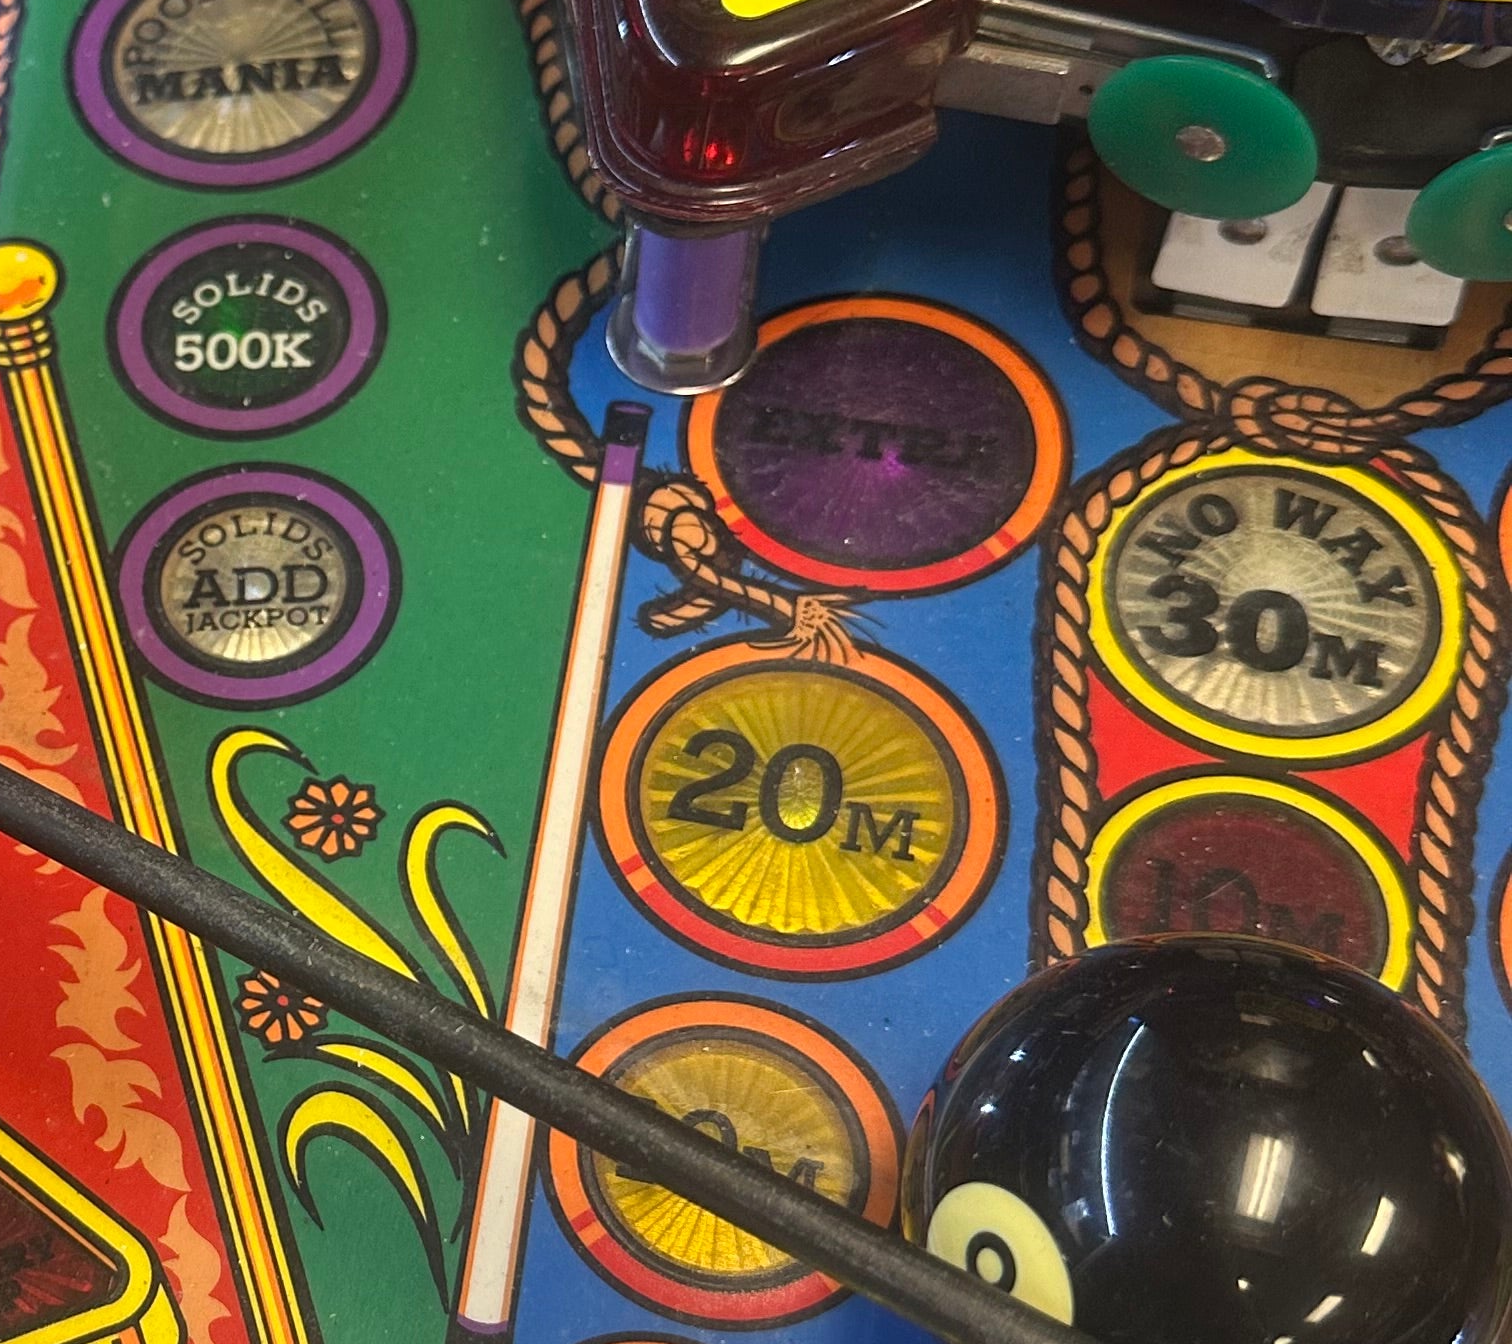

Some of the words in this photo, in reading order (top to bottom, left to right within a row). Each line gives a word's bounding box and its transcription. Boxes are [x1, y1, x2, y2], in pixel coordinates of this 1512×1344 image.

[136, 54, 350, 106] MANIA
[172, 271, 329, 325] SOLIDS
[174, 330, 315, 373] 500K
[178, 512, 335, 565] SOLIDS
[1140, 491, 1239, 567] NO
[1272, 488, 1415, 609] WAY
[182, 562, 330, 610] ADD
[185, 604, 331, 635] JACKPOT
[1140, 573, 1386, 690] 30M
[668, 728, 922, 863] 20M
